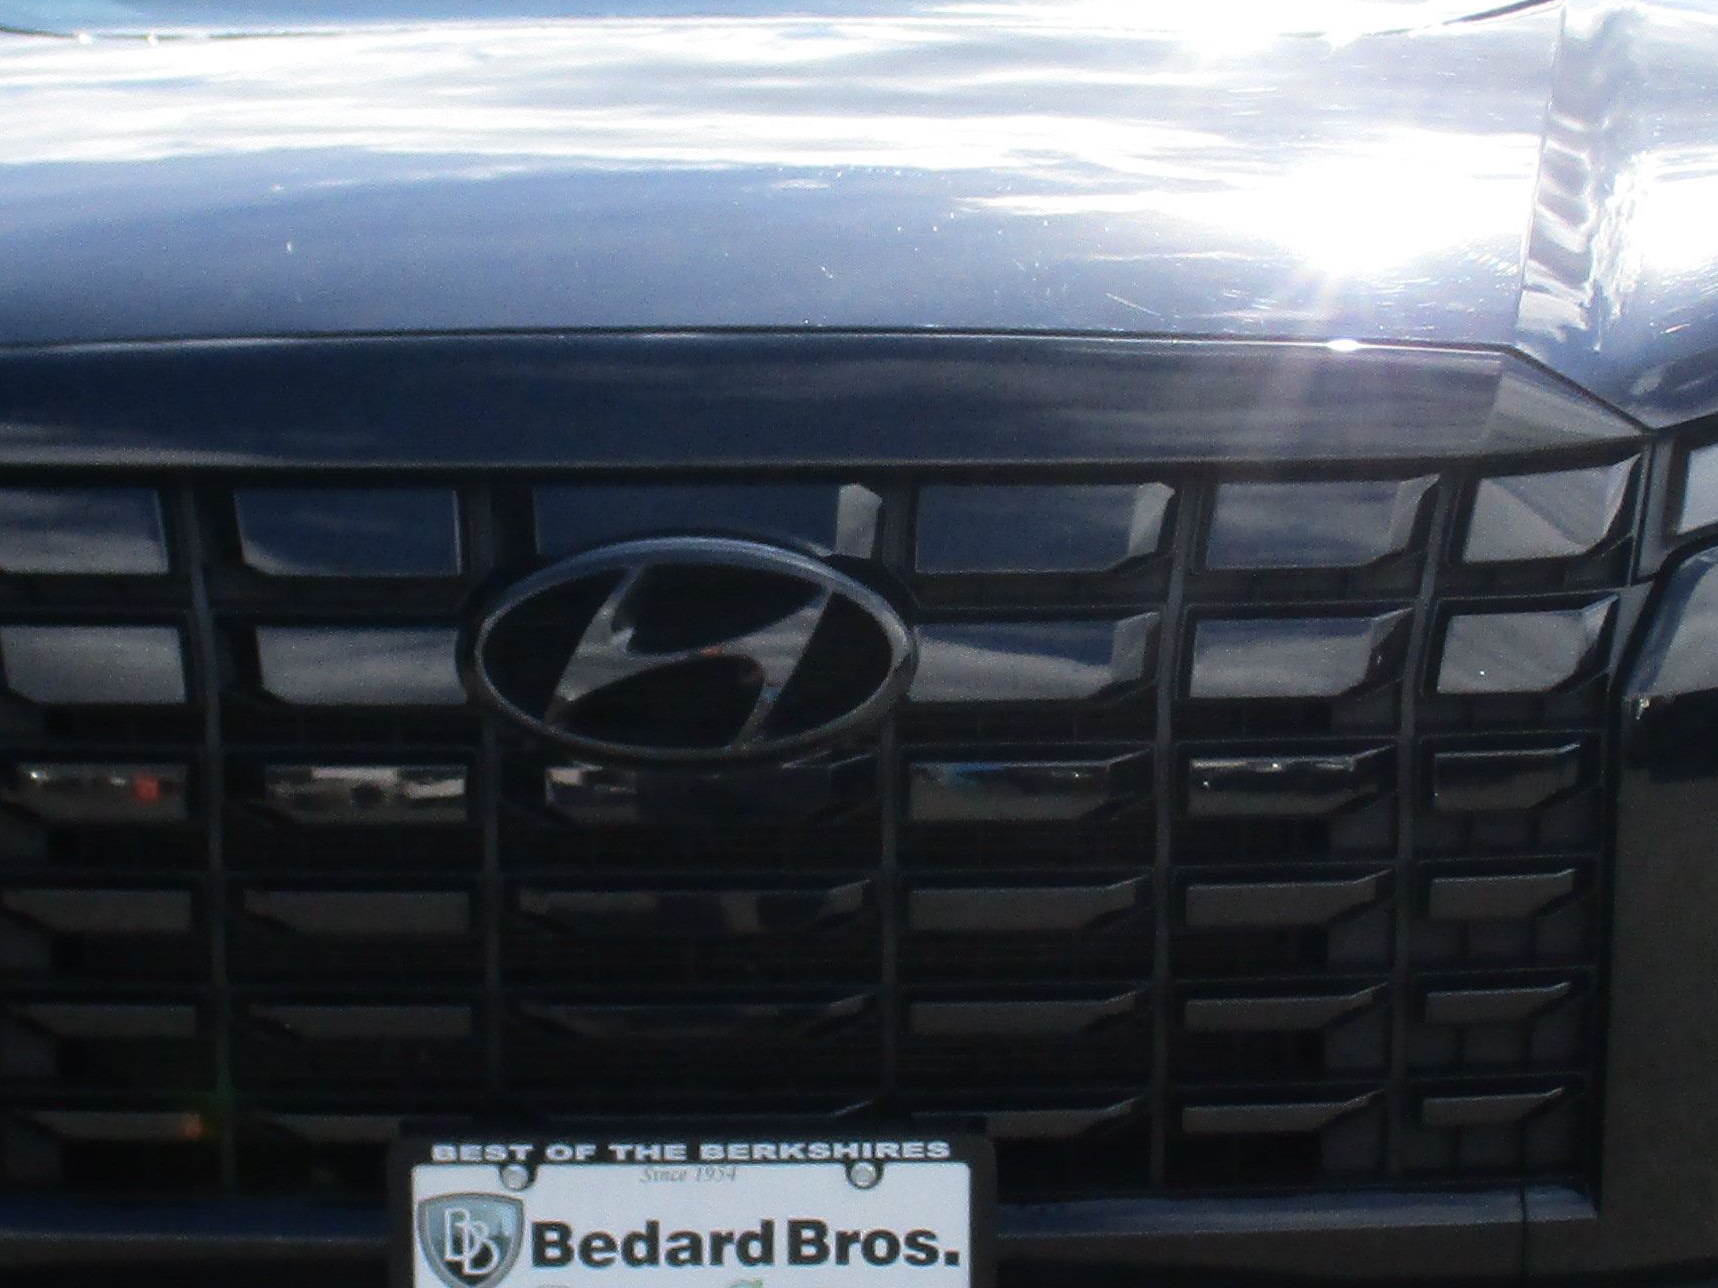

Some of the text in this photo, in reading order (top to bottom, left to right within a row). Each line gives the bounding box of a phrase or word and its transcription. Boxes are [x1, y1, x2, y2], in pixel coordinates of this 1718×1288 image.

[431, 1142, 951, 1162] BEST OF THE BERKSHIRES
[533, 1217, 961, 1268] Bedard Bros.
